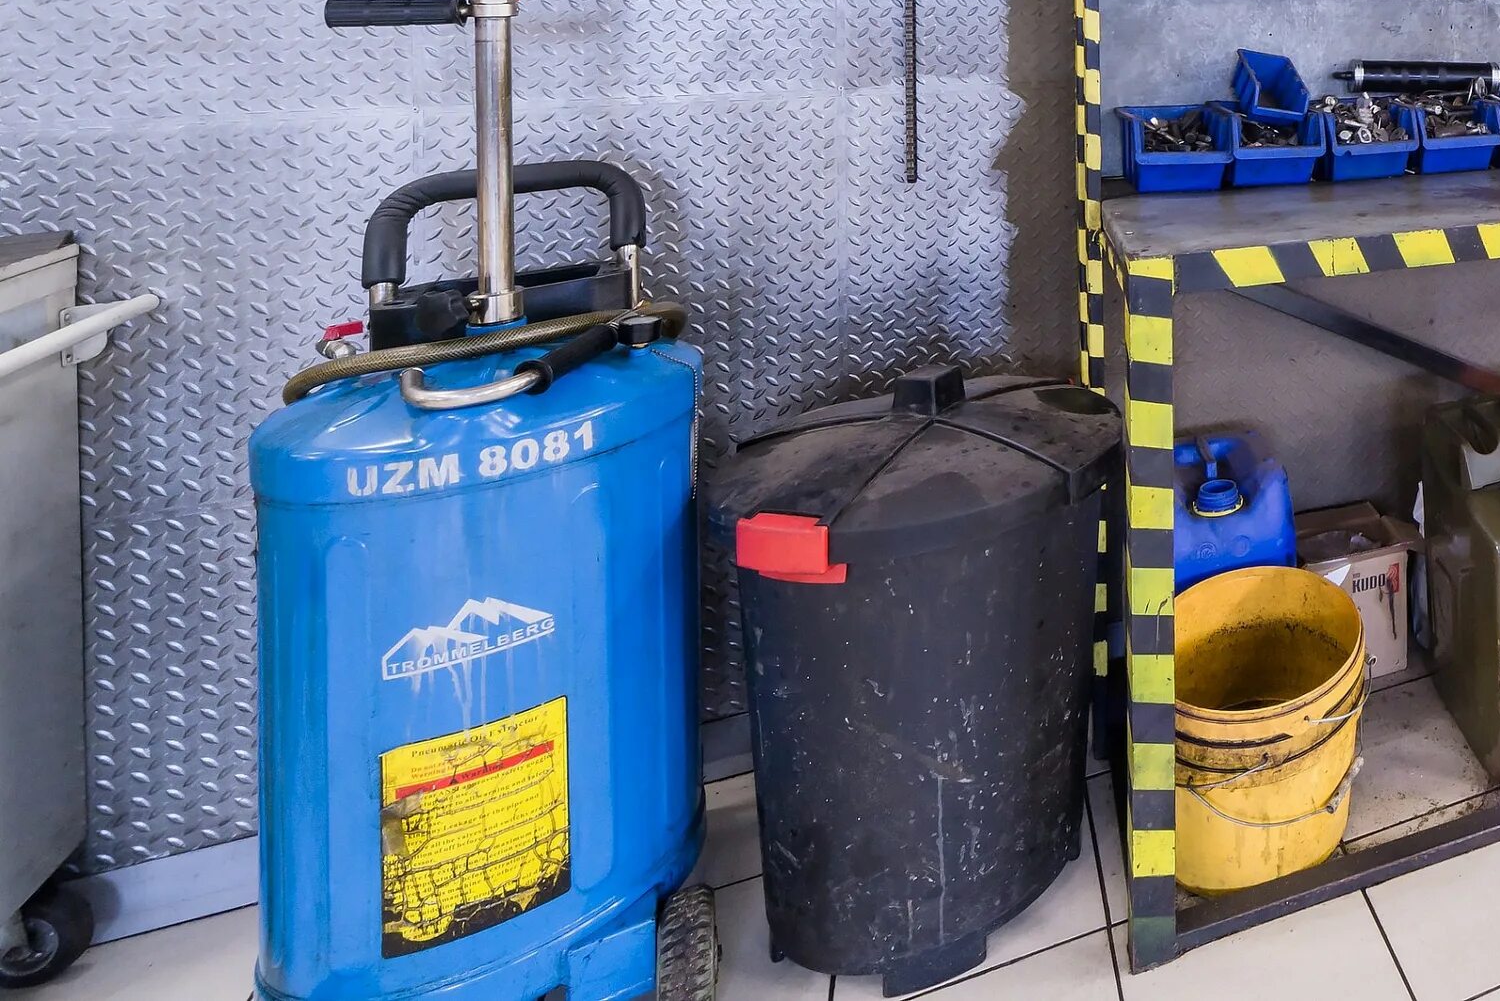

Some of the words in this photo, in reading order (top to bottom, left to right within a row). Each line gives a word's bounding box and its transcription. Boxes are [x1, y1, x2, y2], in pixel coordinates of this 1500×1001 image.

[347, 454, 460, 497] UZM
[478, 421, 593, 477] 8081
[1352, 573, 1386, 594] KUDO
[388, 617, 555, 675] TROMMELBERG
